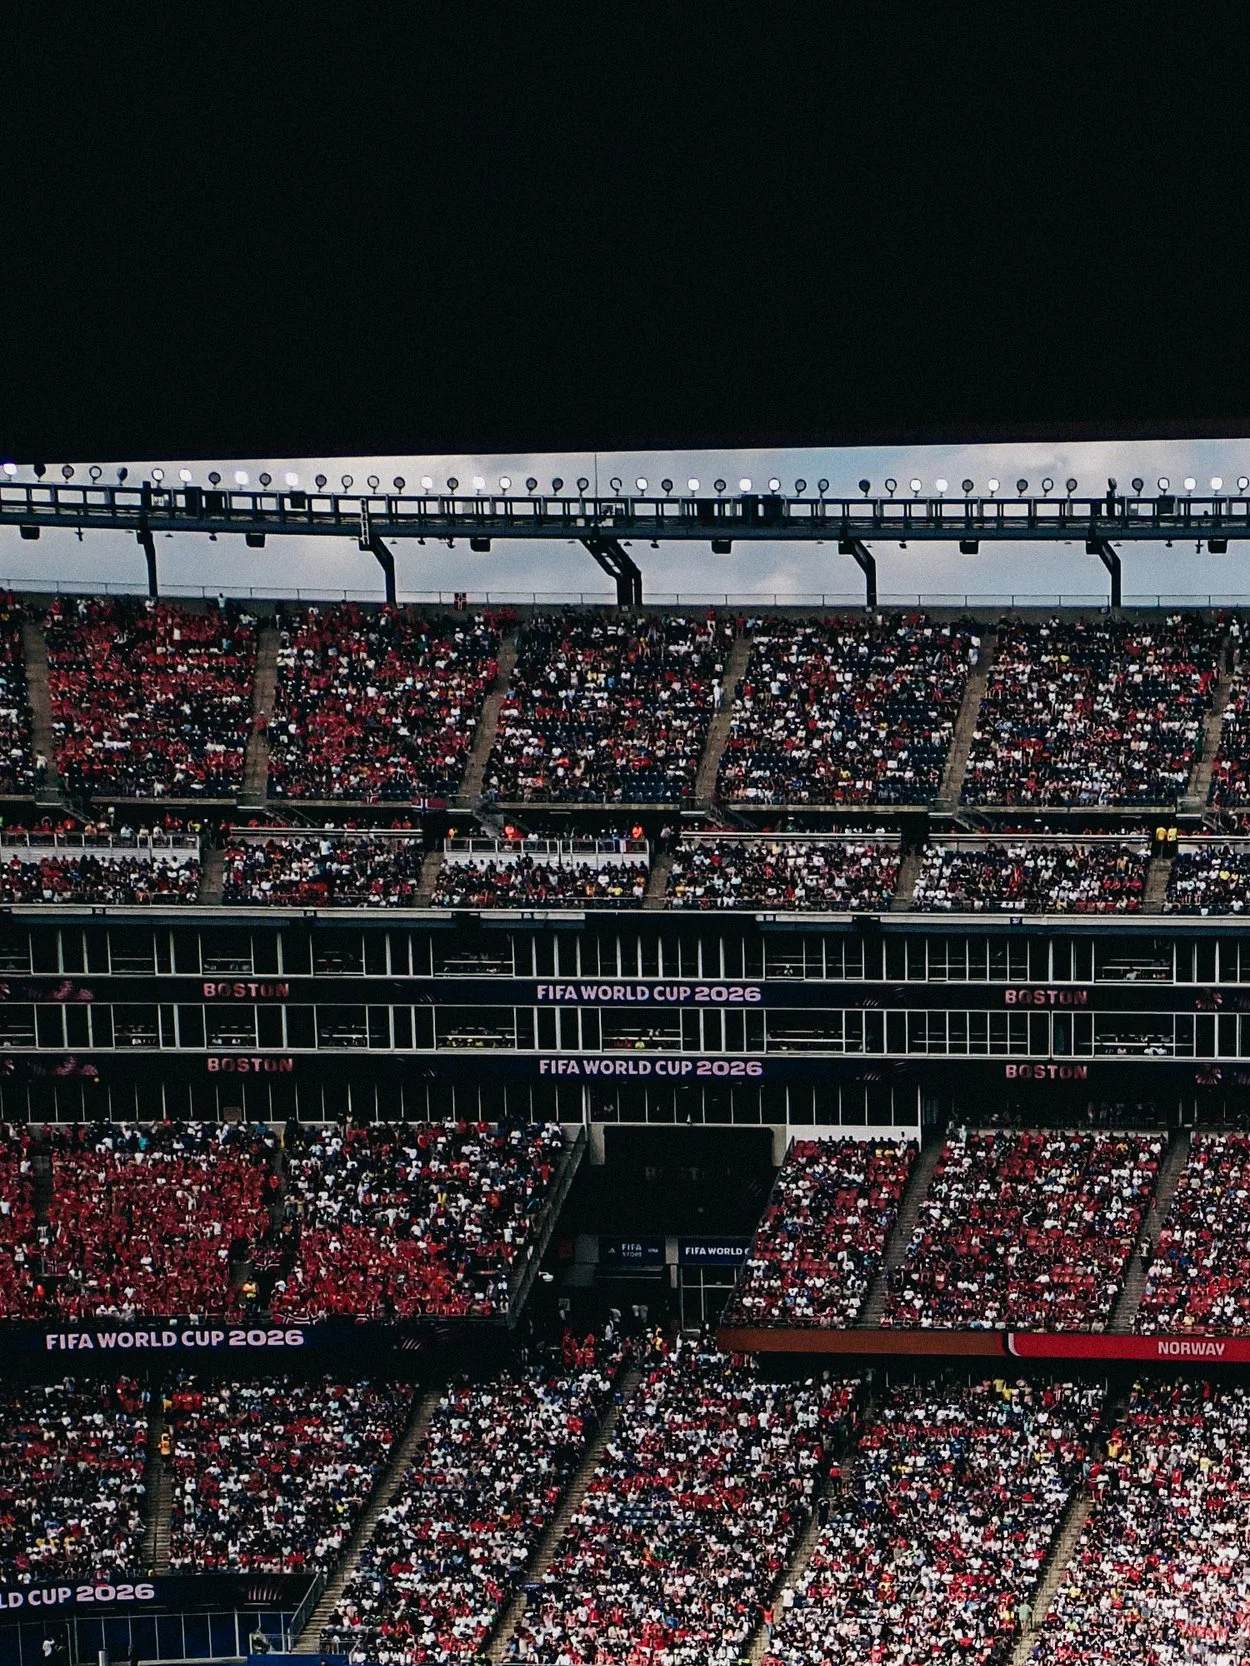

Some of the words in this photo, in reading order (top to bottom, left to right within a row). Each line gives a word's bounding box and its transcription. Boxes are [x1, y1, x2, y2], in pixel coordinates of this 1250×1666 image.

[203, 983, 289, 998] BOSTON
[537, 985, 577, 1001] FIFA
[580, 985, 651, 1002] WORLD
[653, 986, 692, 1002] CUP
[694, 987, 761, 1002] 2026
[1004, 989, 1088, 1005] BOSTON
[207, 1057, 293, 1072] BOSTON
[539, 1060, 580, 1075] FIFA
[582, 1060, 652, 1076] WORLD
[654, 1061, 692, 1076] CUP
[696, 1061, 763, 1077] 2026
[1004, 1064, 1088, 1081] BOSTON
[621, 1243, 642, 1252] FIFA
[685, 1246, 707, 1256] FIFA
[708, 1247, 742, 1256] WORLD
[46, 1333, 94, 1350] FIFA
[97, 1331, 178, 1348] WORLD
[181, 1330, 225, 1347] CUP
[227, 1329, 304, 1346] 2026
[1157, 1341, 1225, 1357] NORWAY
[27, 1587, 72, 1607] CUP
[76, 1583, 156, 1602] 2026
